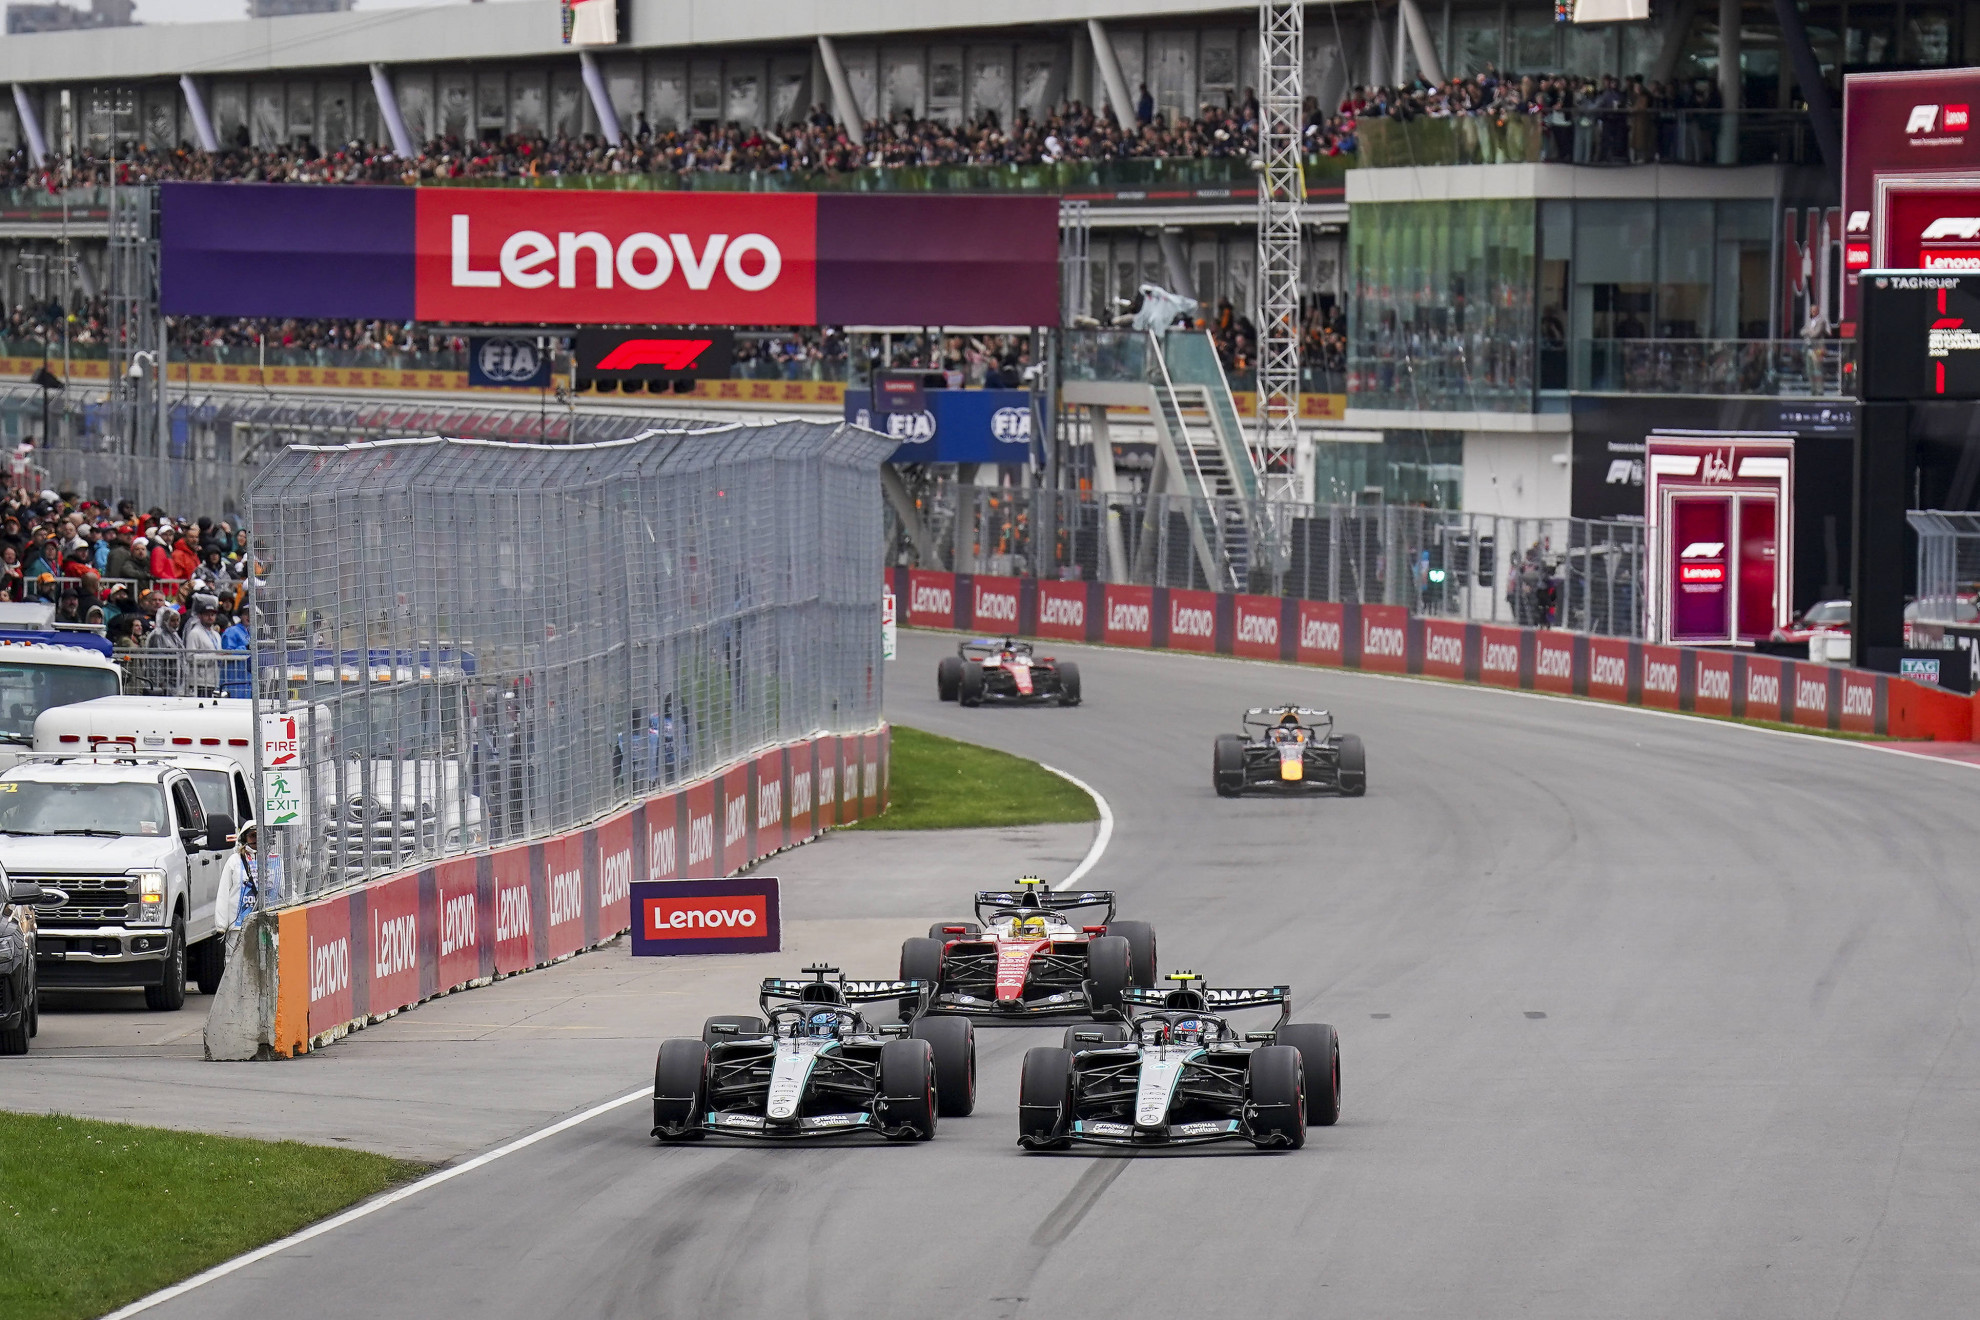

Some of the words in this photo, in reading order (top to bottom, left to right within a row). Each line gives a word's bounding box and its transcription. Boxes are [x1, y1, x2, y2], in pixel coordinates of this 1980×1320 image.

[1946, 109, 1968, 125] Lenovo
[452, 214, 782, 291] Lenovo
[1847, 248, 1868, 263] Lenovo
[1684, 567, 1721, 578] Lenovo
[912, 580, 951, 614] Lenovo
[976, 585, 1016, 621] Lenovo
[1040, 591, 1083, 626] Lenovo
[1108, 597, 1149, 632] Lenovo
[1172, 600, 1213, 637] Lenovo
[1237, 607, 1278, 644] Lenovo
[1301, 613, 1340, 650] Lenovo
[1364, 618, 1404, 656] Lenovo
[1426, 628, 1462, 665] Lenovo
[1482, 637, 1518, 672] Lenovo
[1536, 641, 1570, 678] Lenovo
[1591, 648, 1626, 686] Lenovo
[1644, 654, 1677, 693] Lenovo
[1698, 661, 1730, 699] Lenovo
[1748, 667, 1778, 704] Lenovo
[1904, 661, 1936, 672] TAG
[1796, 672, 1826, 712] Lenovo
[1842, 678, 1872, 716] Lenovo
[265, 741, 297, 751] FIRE
[791, 766, 811, 818] Lenovo
[818, 759, 835, 806] Lenovo
[267, 800, 299, 810] EXIT
[725, 792, 746, 847] Lenovo
[758, 776, 781, 828] Lenovo
[649, 823, 675, 880] Lenovo
[688, 809, 713, 865] Lenovo
[548, 864, 581, 926] Lenovo
[600, 847, 631, 908] Lenovo
[440, 889, 475, 957] Lenovo
[495, 877, 530, 942] Lenovo
[654, 907, 756, 929] Lenovo
[375, 909, 416, 978] Lenovo
[310, 936, 348, 1002] Lenovo
